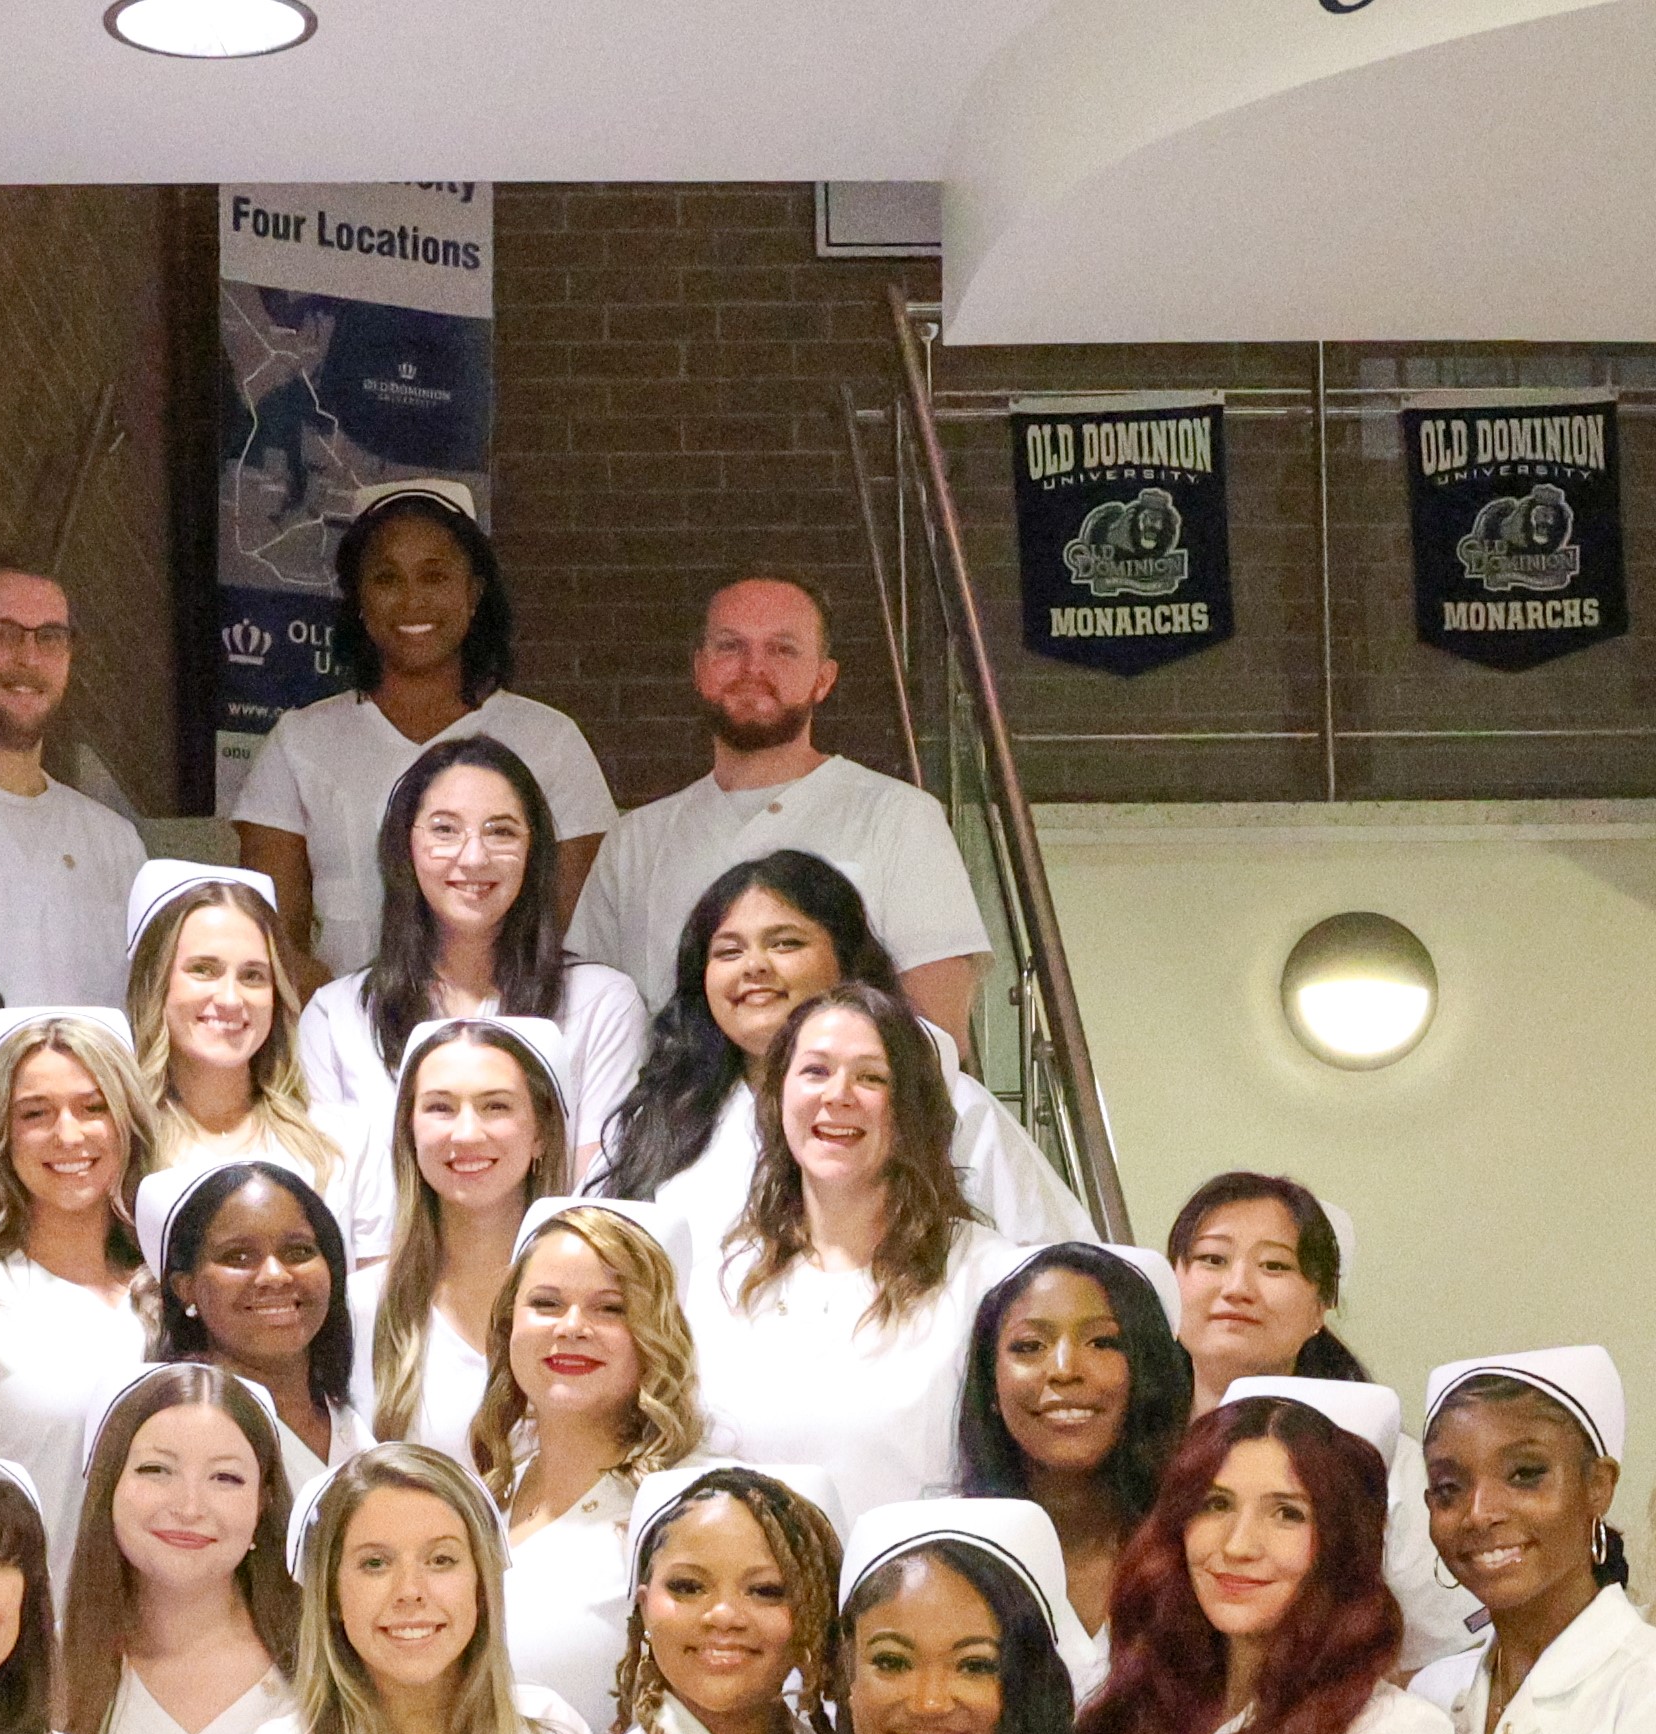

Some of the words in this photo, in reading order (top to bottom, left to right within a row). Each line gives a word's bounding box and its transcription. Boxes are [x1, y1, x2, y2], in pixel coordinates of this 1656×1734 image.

[232, 195, 307, 243] Four
[317, 210, 481, 270] Locations
[1027, 424, 1075, 480] OLD
[1083, 417, 1211, 473] DOMINION
[1420, 419, 1468, 476] OLD
[1476, 415, 1605, 470] DOMINION
[1044, 469, 1199, 490] UNIVERSITY
[1438, 465, 1591, 485] UNIVERSITY
[1050, 602, 1210, 637] MONARCHS
[1444, 598, 1600, 631] MONARCHS
